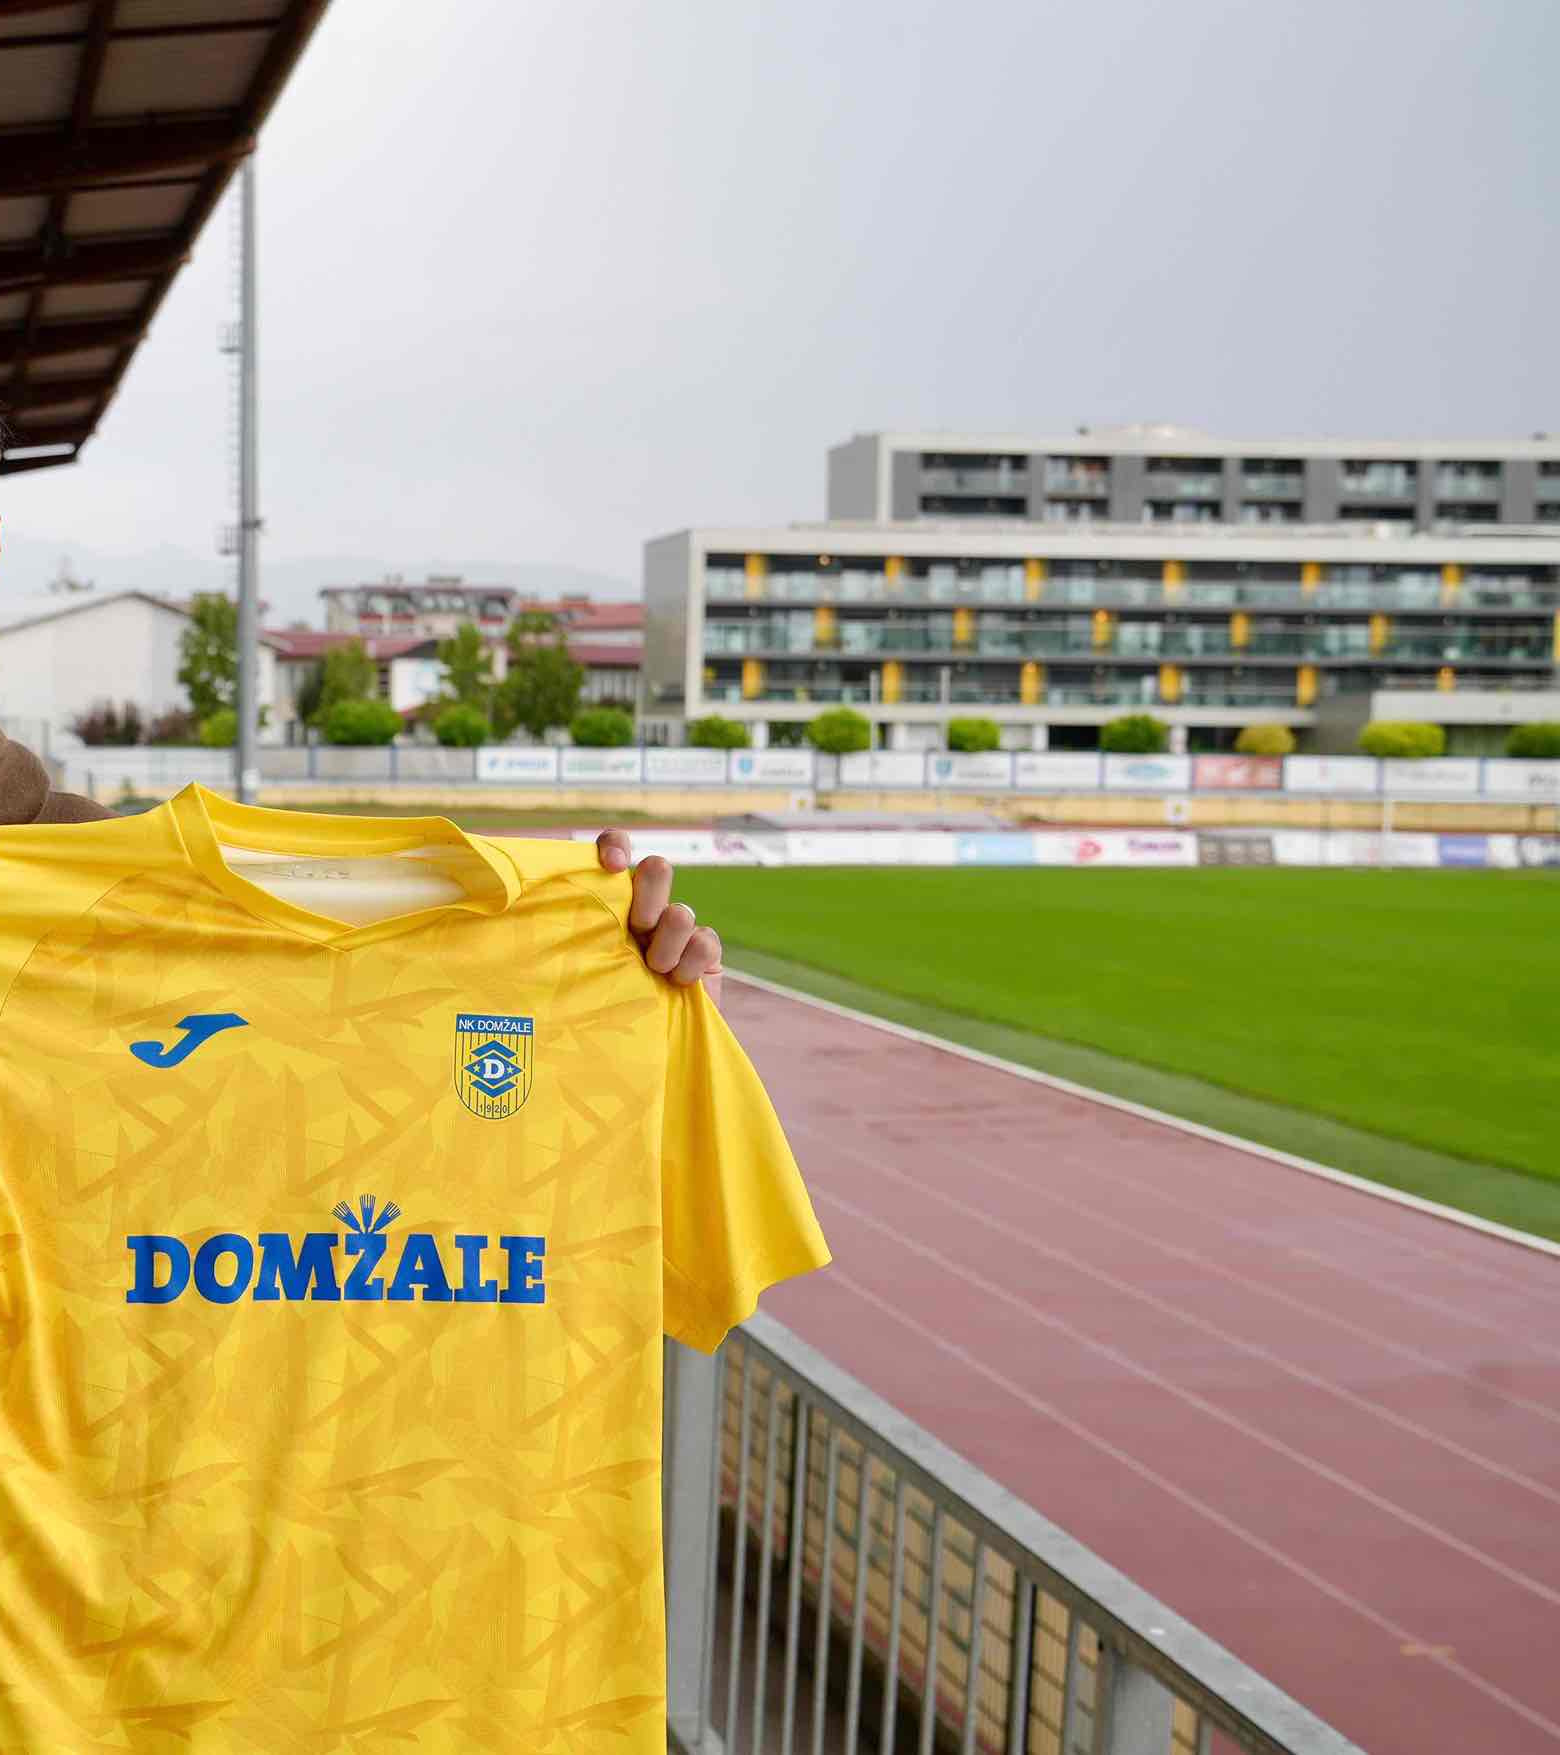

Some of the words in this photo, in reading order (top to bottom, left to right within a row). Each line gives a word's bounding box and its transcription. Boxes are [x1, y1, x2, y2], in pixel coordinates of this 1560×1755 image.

[458, 1019, 475, 1031] NK
[478, 1019, 531, 1033] DOMŽALE
[483, 1059, 505, 1079] D
[126, 1194, 545, 1304] DOMŽALE
